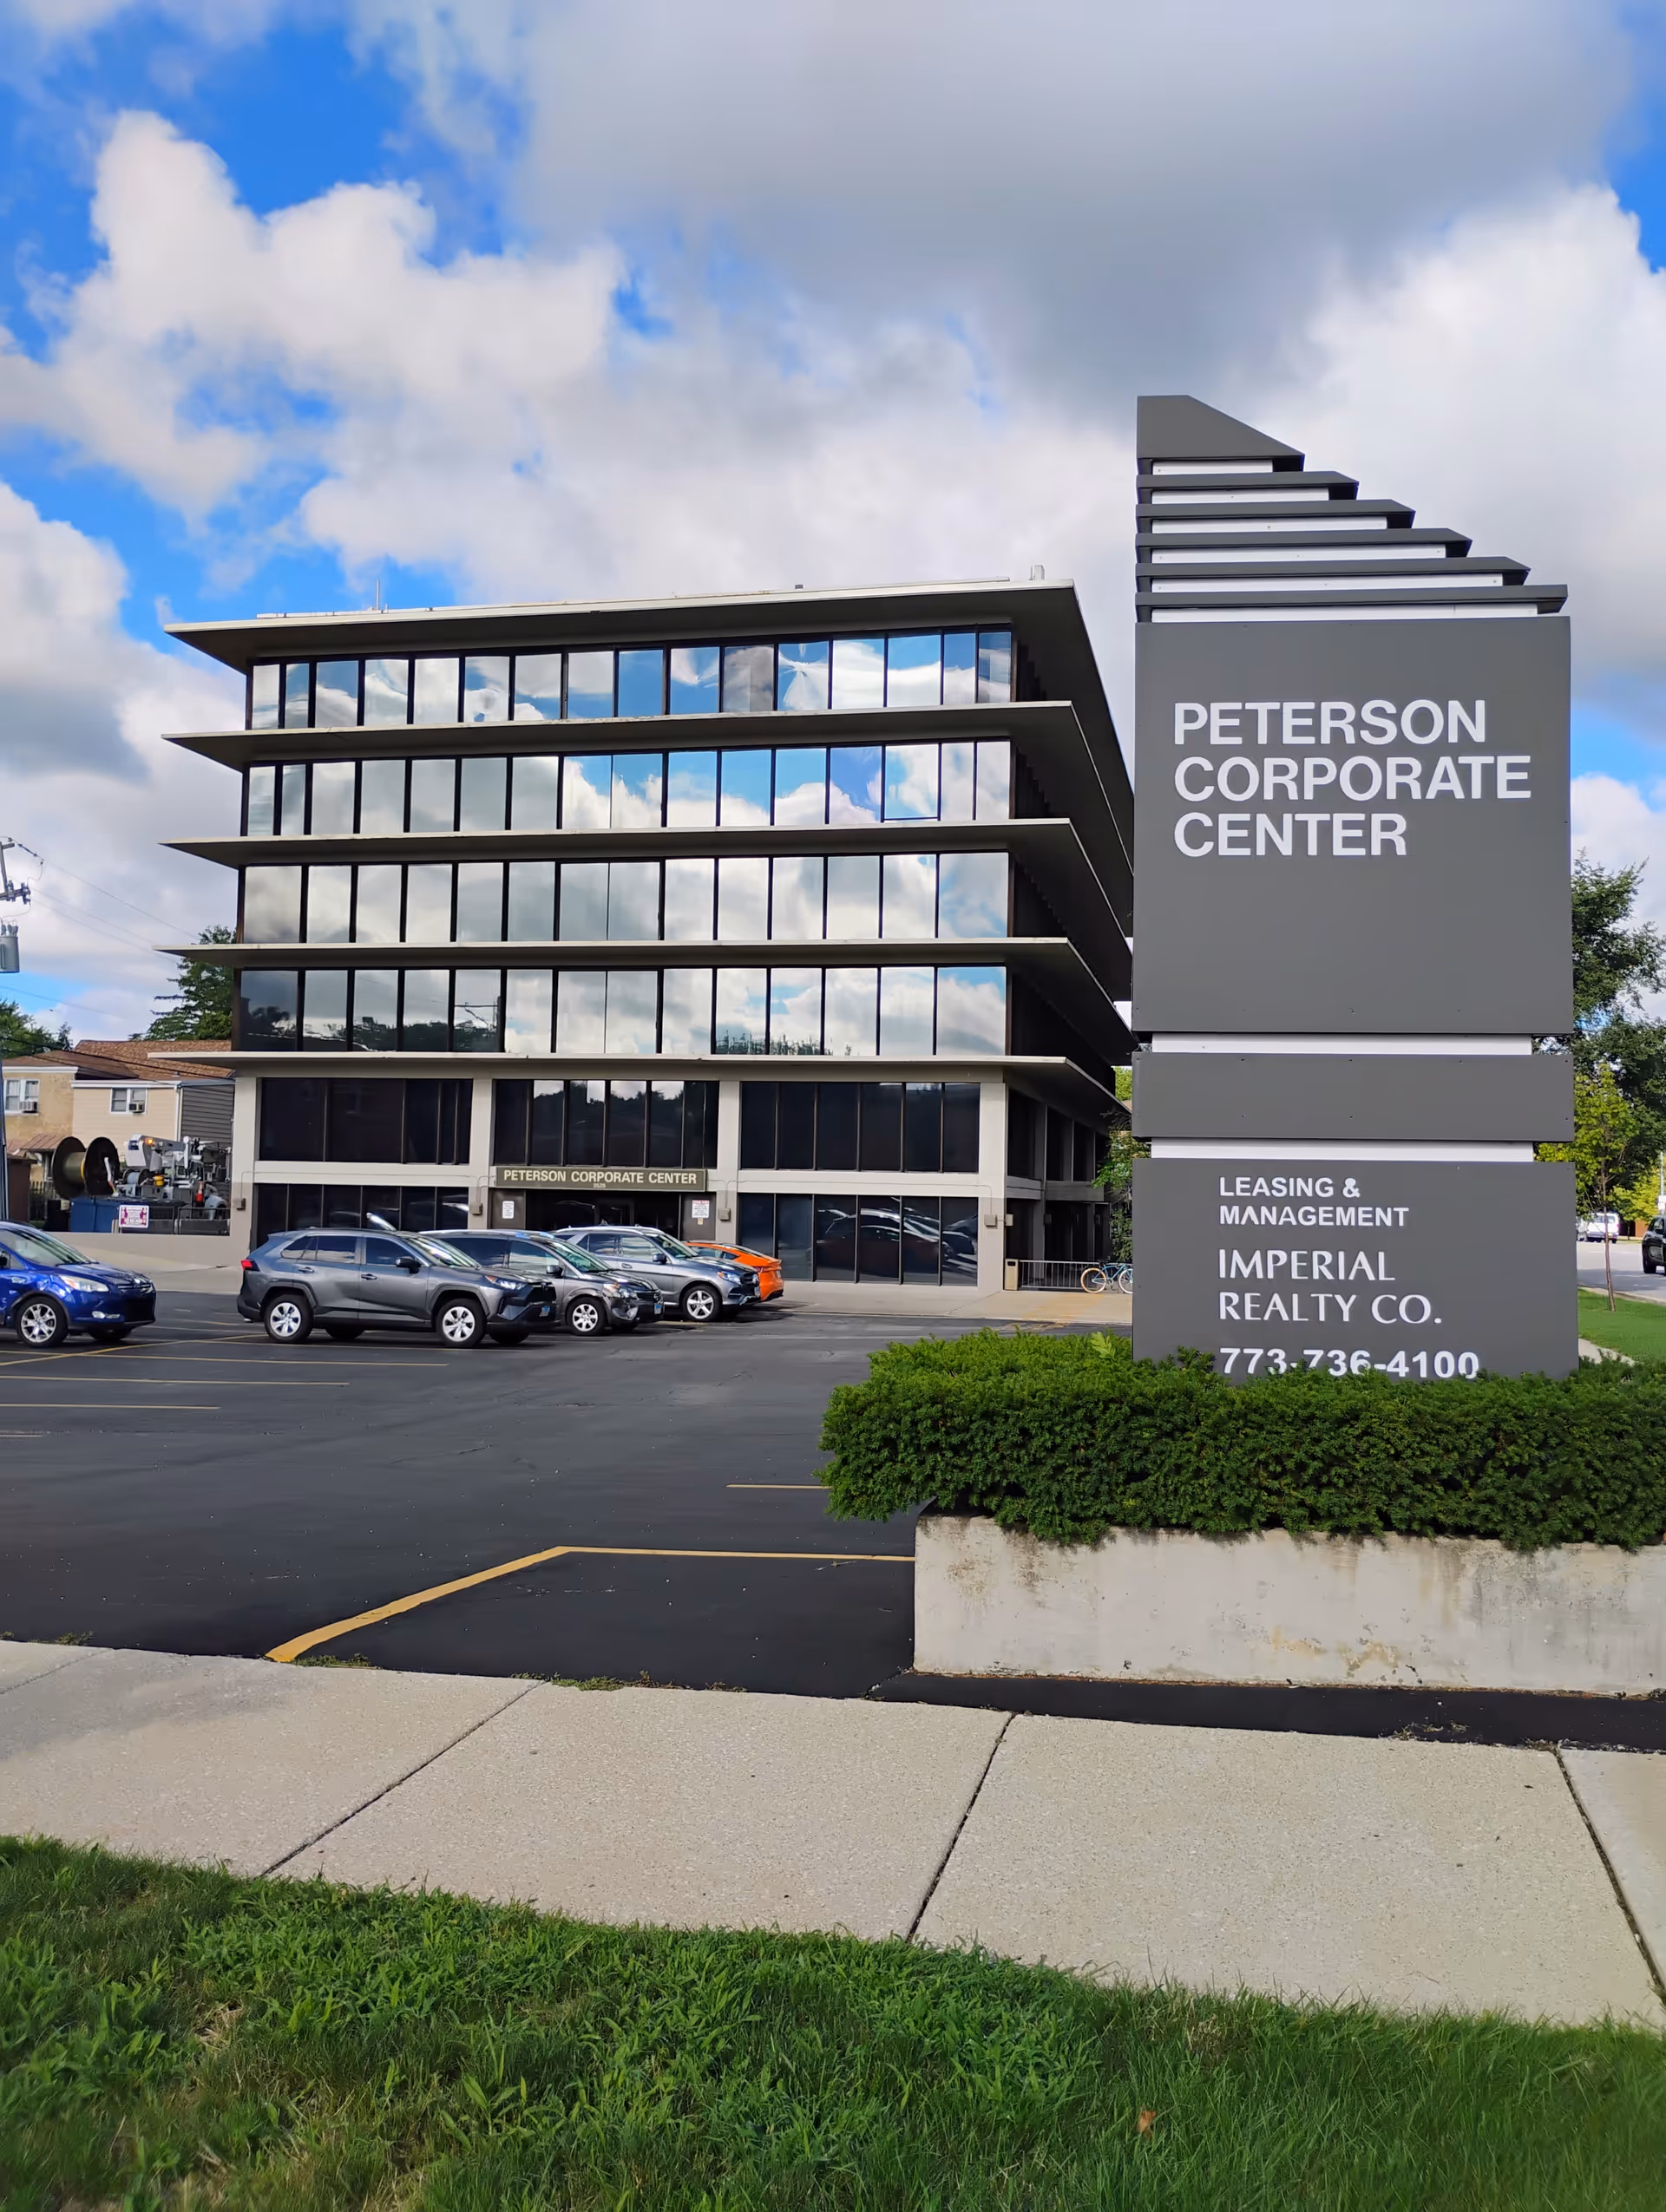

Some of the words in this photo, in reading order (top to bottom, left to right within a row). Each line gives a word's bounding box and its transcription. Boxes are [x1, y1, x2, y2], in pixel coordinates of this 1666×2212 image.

[1174, 698, 1486, 745] PETERSON
[1174, 755, 1532, 802] CORPORATE
[1174, 811, 1407, 858] CENTER
[503, 1169, 567, 1181] PETERSON
[571, 1170, 645, 1183] CORPORATE
[648, 1172, 698, 1184] CENTER
[1219, 1176, 1334, 1198] LEASING
[1342, 1177, 1361, 1198] &
[1219, 1205, 1410, 1227] MANAGEMENT
[1219, 1248, 1396, 1281] IMPERIAL
[1219, 1292, 1357, 1322] REALTY
[1371, 1294, 1442, 1325] CO.
[1219, 1347, 1479, 1379] 773-736-4100
